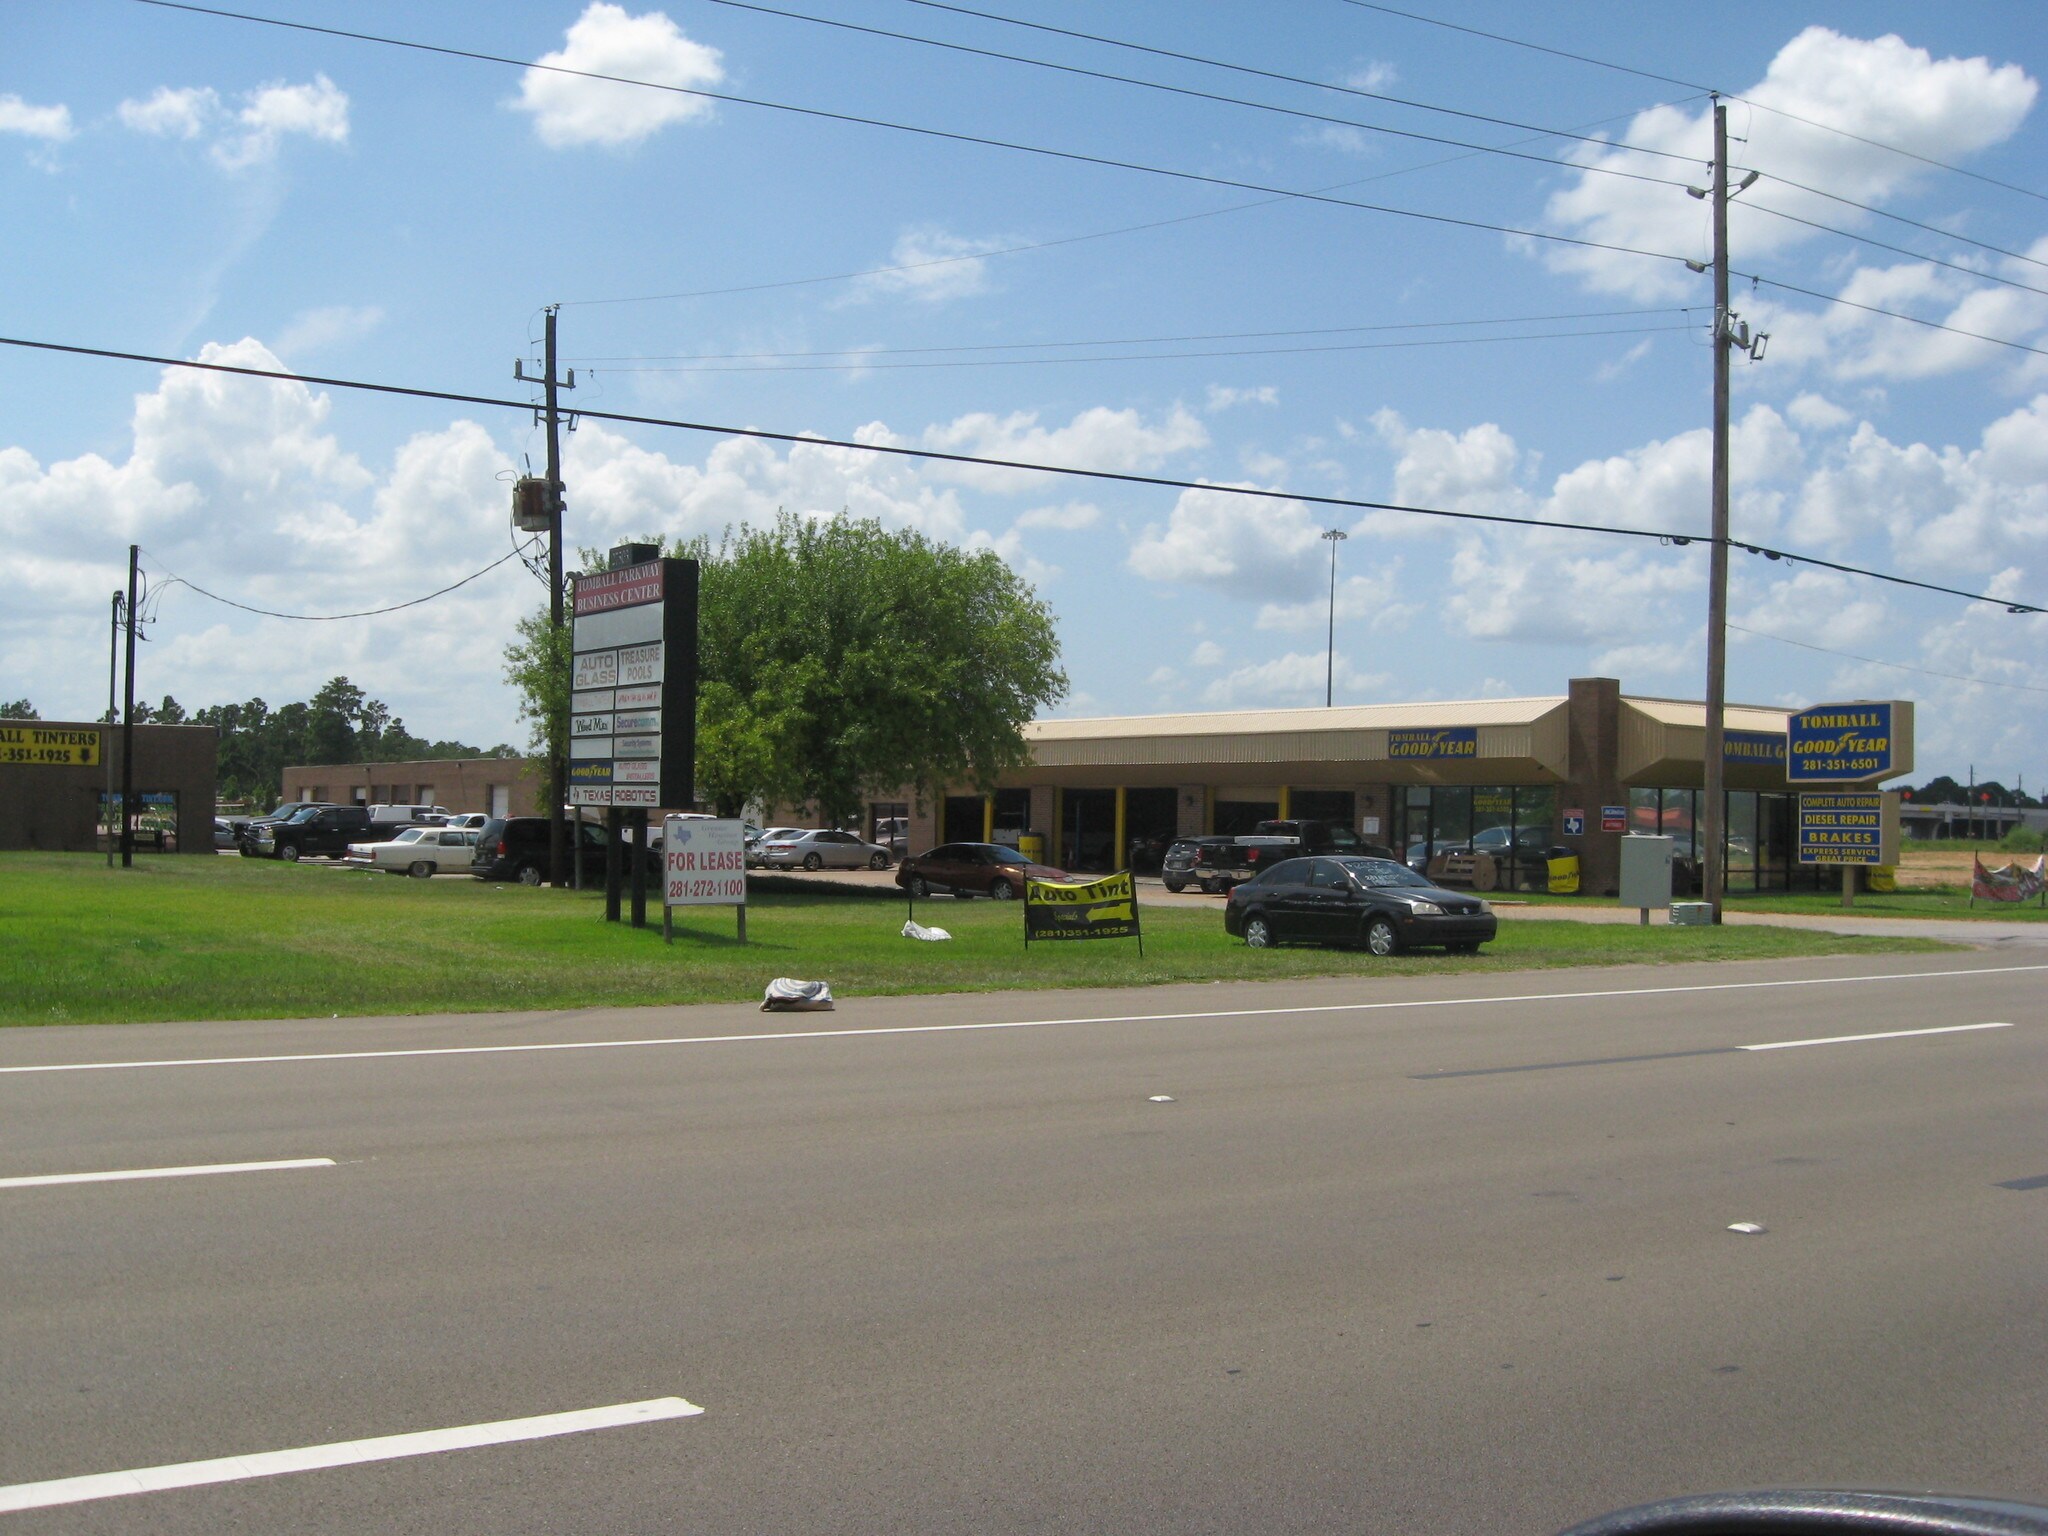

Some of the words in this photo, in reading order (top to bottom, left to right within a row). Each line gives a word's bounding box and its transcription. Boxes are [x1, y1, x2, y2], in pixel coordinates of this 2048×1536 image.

[578, 572, 617, 593] TOMBALL
[619, 562, 660, 583] PARKWAY
[577, 591, 619, 612] BUSINESS
[621, 584, 660, 603] CENTER
[580, 654, 614, 671] AUTO
[620, 647, 660, 665] TREASURE
[575, 669, 616, 687] GLASS
[627, 665, 653, 681] POOLS
[1800, 713, 1880, 729] TOMBALL
[33, 731, 97, 746] TINTERS
[1391, 733, 1431, 742] TOMBALL
[1390, 739, 1475, 757] GOODYEAR
[1724, 741, 1773, 758] OMBALL
[1793, 735, 1888, 756] GOODYEAR
[0, 748, 71, 763] -351-1925
[571, 766, 611, 778] GOODYEAR
[1802, 758, 1879, 771] 281-351-6501
[583, 790, 611, 801] TEXAS
[615, 790, 657, 802] ROBOTICS
[1802, 797, 1836, 808] COMPLETE
[1837, 797, 1856, 807] AUTO
[1856, 797, 1881, 807] REPAIR
[1805, 814, 1837, 824] DIESEL
[1840, 814, 1877, 825] REPAIR
[1809, 832, 1872, 843] BRAKES
[1803, 847, 1839, 855] EXPRESS
[1815, 854, 1841, 862] GREAT
[668, 852, 695, 871] FOR
[700, 851, 743, 871] LEASE
[1029, 884, 1077, 902] Auto
[1081, 879, 1130, 899] Tint
[1034, 925, 1129, 939] (281)351-1925
